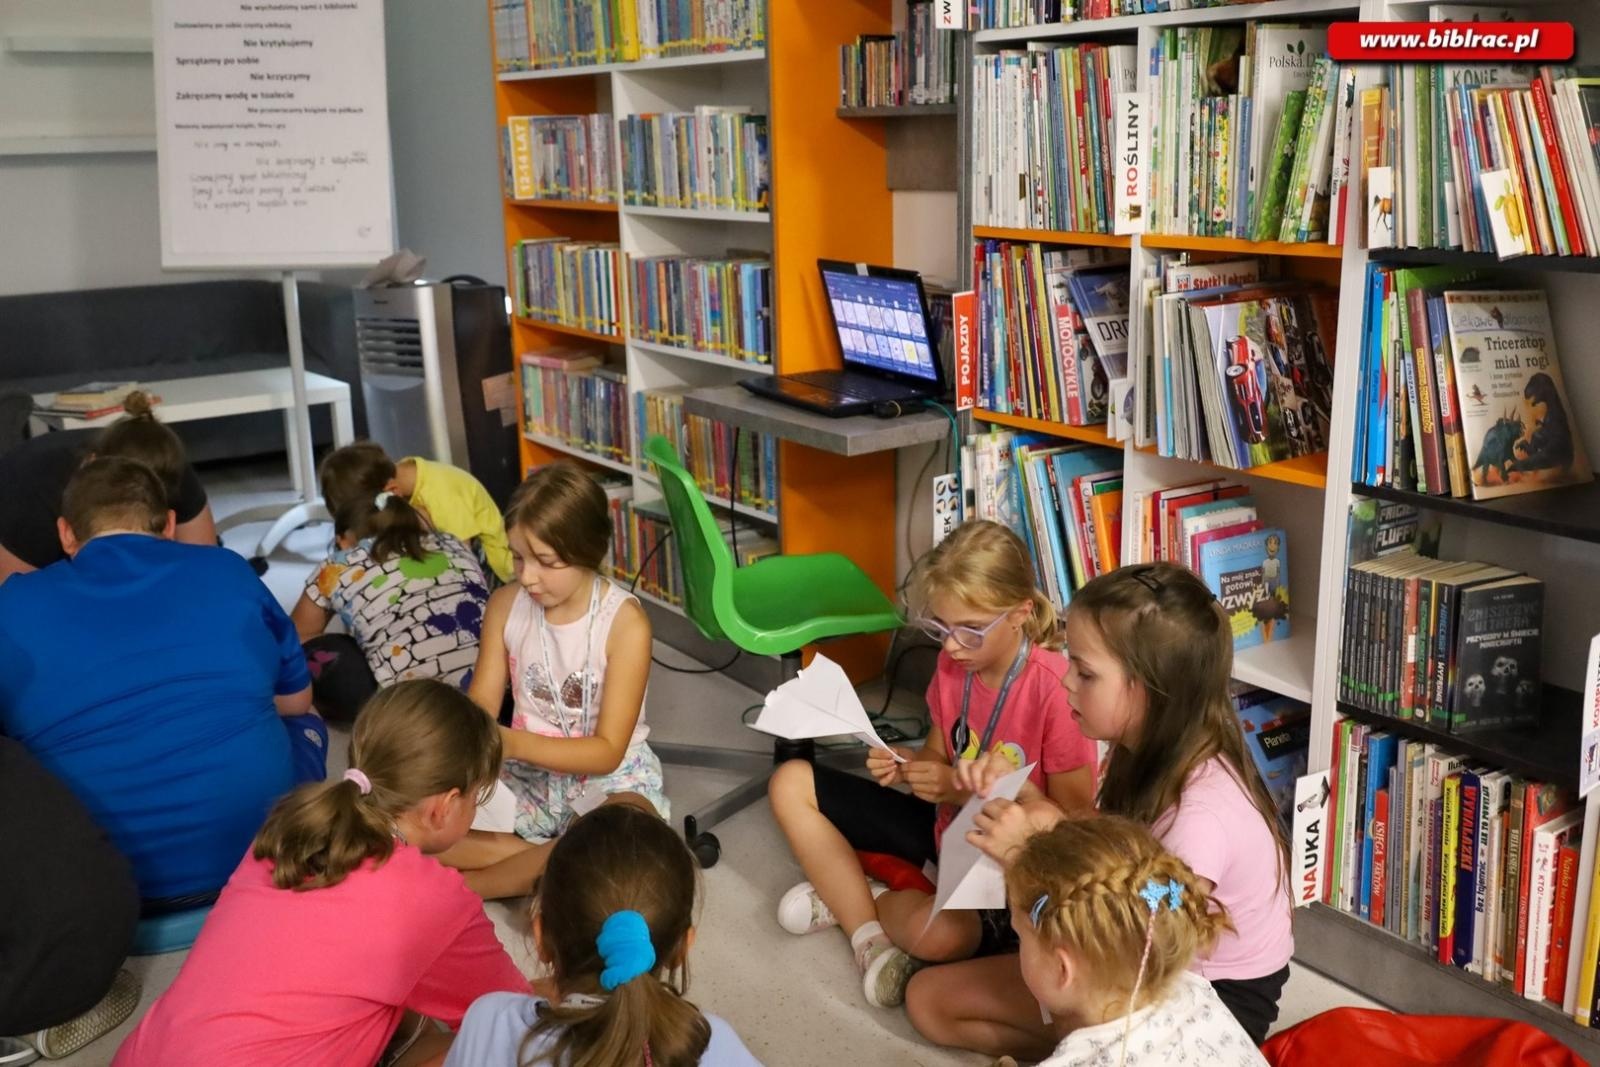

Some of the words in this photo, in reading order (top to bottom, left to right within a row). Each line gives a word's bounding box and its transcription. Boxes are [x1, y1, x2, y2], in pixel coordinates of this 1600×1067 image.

[243, 39, 258, 48] Nie
[260, 39, 313, 48] krytykujemy
[175, 57, 222, 66] Sprzątamy
[223, 58, 235, 66] po
[237, 57, 260, 65] sobie
[250, 73, 264, 81] Nie
[267, 73, 311, 82] krzyczymy
[175, 92, 222, 101] Zakręcamy
[225, 92, 249, 101] wodę
[261, 91, 295, 99] toalecie
[1123, 99, 1140, 197] ROŚLINY
[959, 314, 971, 386] POJAZDY
[1484, 335, 1547, 353] Triceratop
[1058, 316, 1079, 398] MOTOCYKLE
[1494, 354, 1521, 370] miał
[1526, 354, 1550, 370] rogi
[1221, 576, 1230, 585] Na
[1460, 785, 1477, 873] WYNALAZKI
[1302, 818, 1321, 901] NAUKA
[1561, 855, 1573, 888] Nauka
